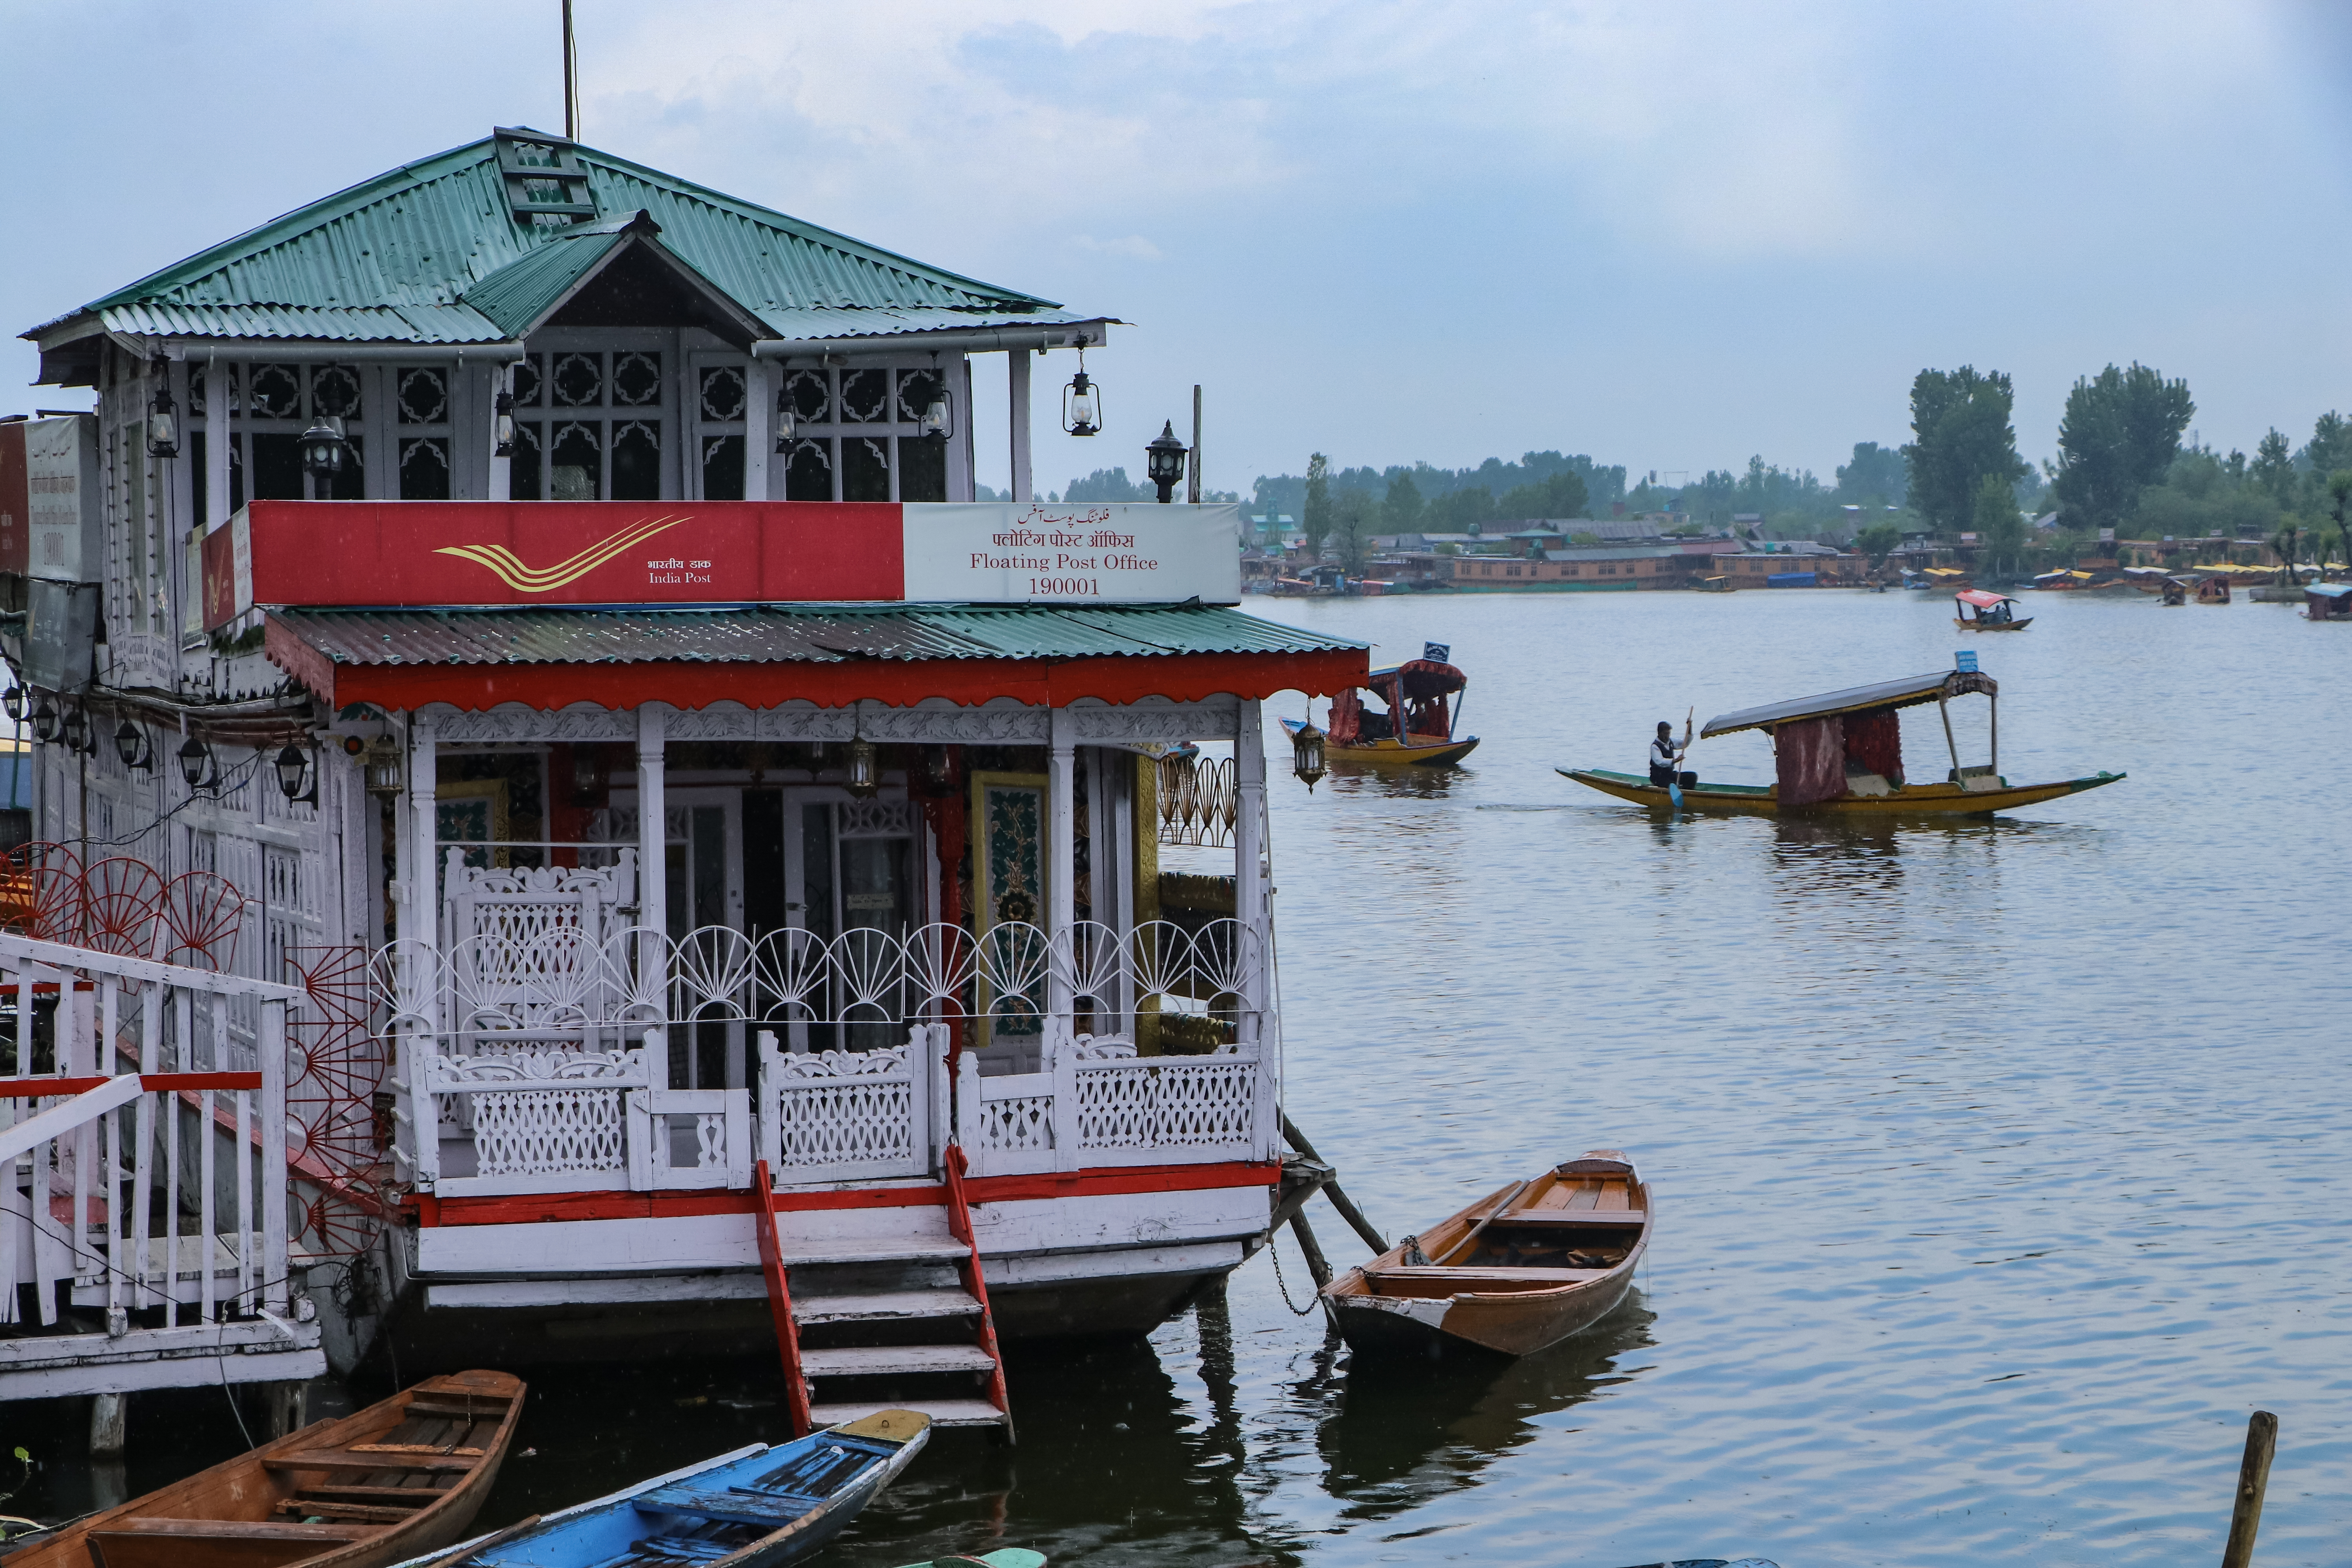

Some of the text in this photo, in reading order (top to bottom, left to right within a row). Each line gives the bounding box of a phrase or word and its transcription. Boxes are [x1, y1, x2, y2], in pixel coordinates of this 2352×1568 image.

[1018, 504, 1109, 528] فلوٹنگ پوسٹ آفس
[992, 529, 1135, 548] फ्लोटिंग पोस्ट ऑफिस
[647, 557, 711, 569] भारतीय डाक
[970, 553, 1158, 572] Floating Post Office
[649, 572, 711, 583] India Post
[1029, 578, 1099, 595] 190001
